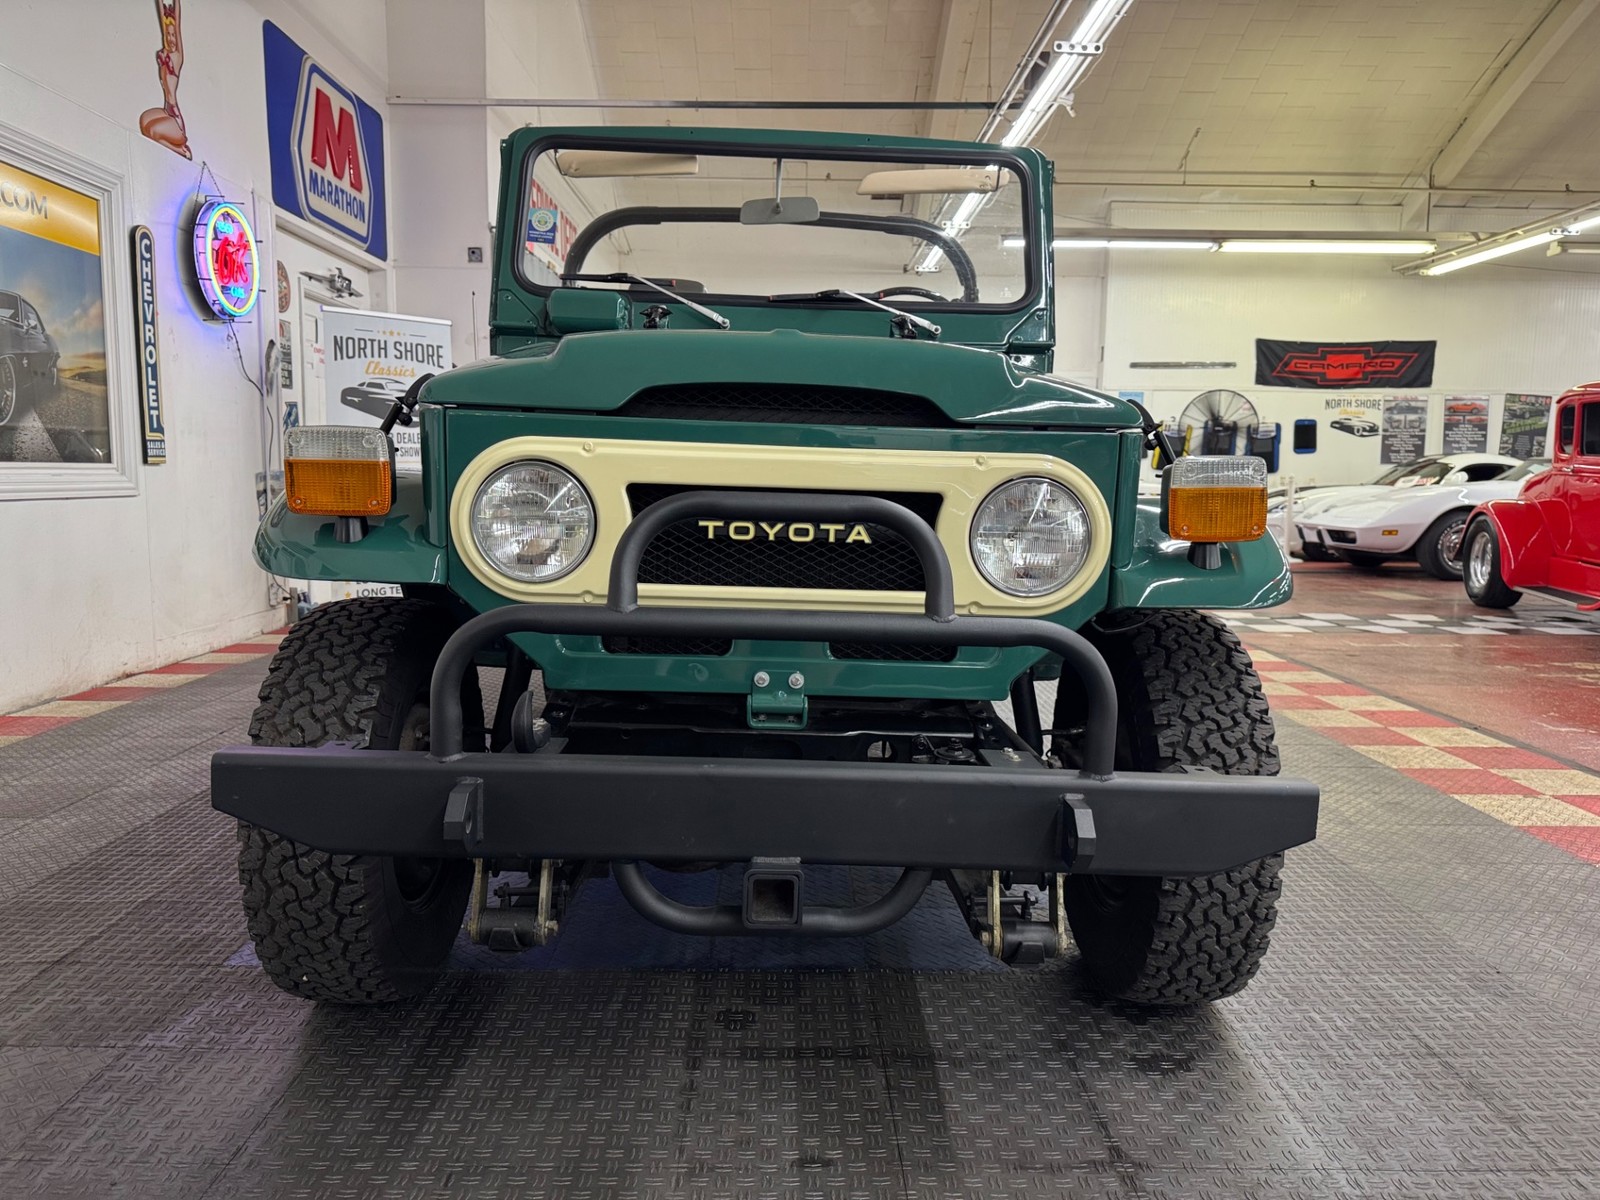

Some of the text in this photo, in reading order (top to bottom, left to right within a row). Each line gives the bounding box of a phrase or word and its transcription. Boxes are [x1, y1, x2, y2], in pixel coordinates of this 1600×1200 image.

[311, 87, 363, 194] M
[0, 182, 48, 219] COM
[309, 168, 366, 223] MARATHON
[140, 238, 159, 429] CHEVROLET
[333, 335, 444, 369] NORTH SHORE
[1293, 360, 1396, 371] CAMARO
[365, 360, 416, 378] Classics
[1325, 398, 1382, 411] NORTH SHORE
[698, 520, 872, 544] TOYOTA
[356, 586, 387, 598] LONG
